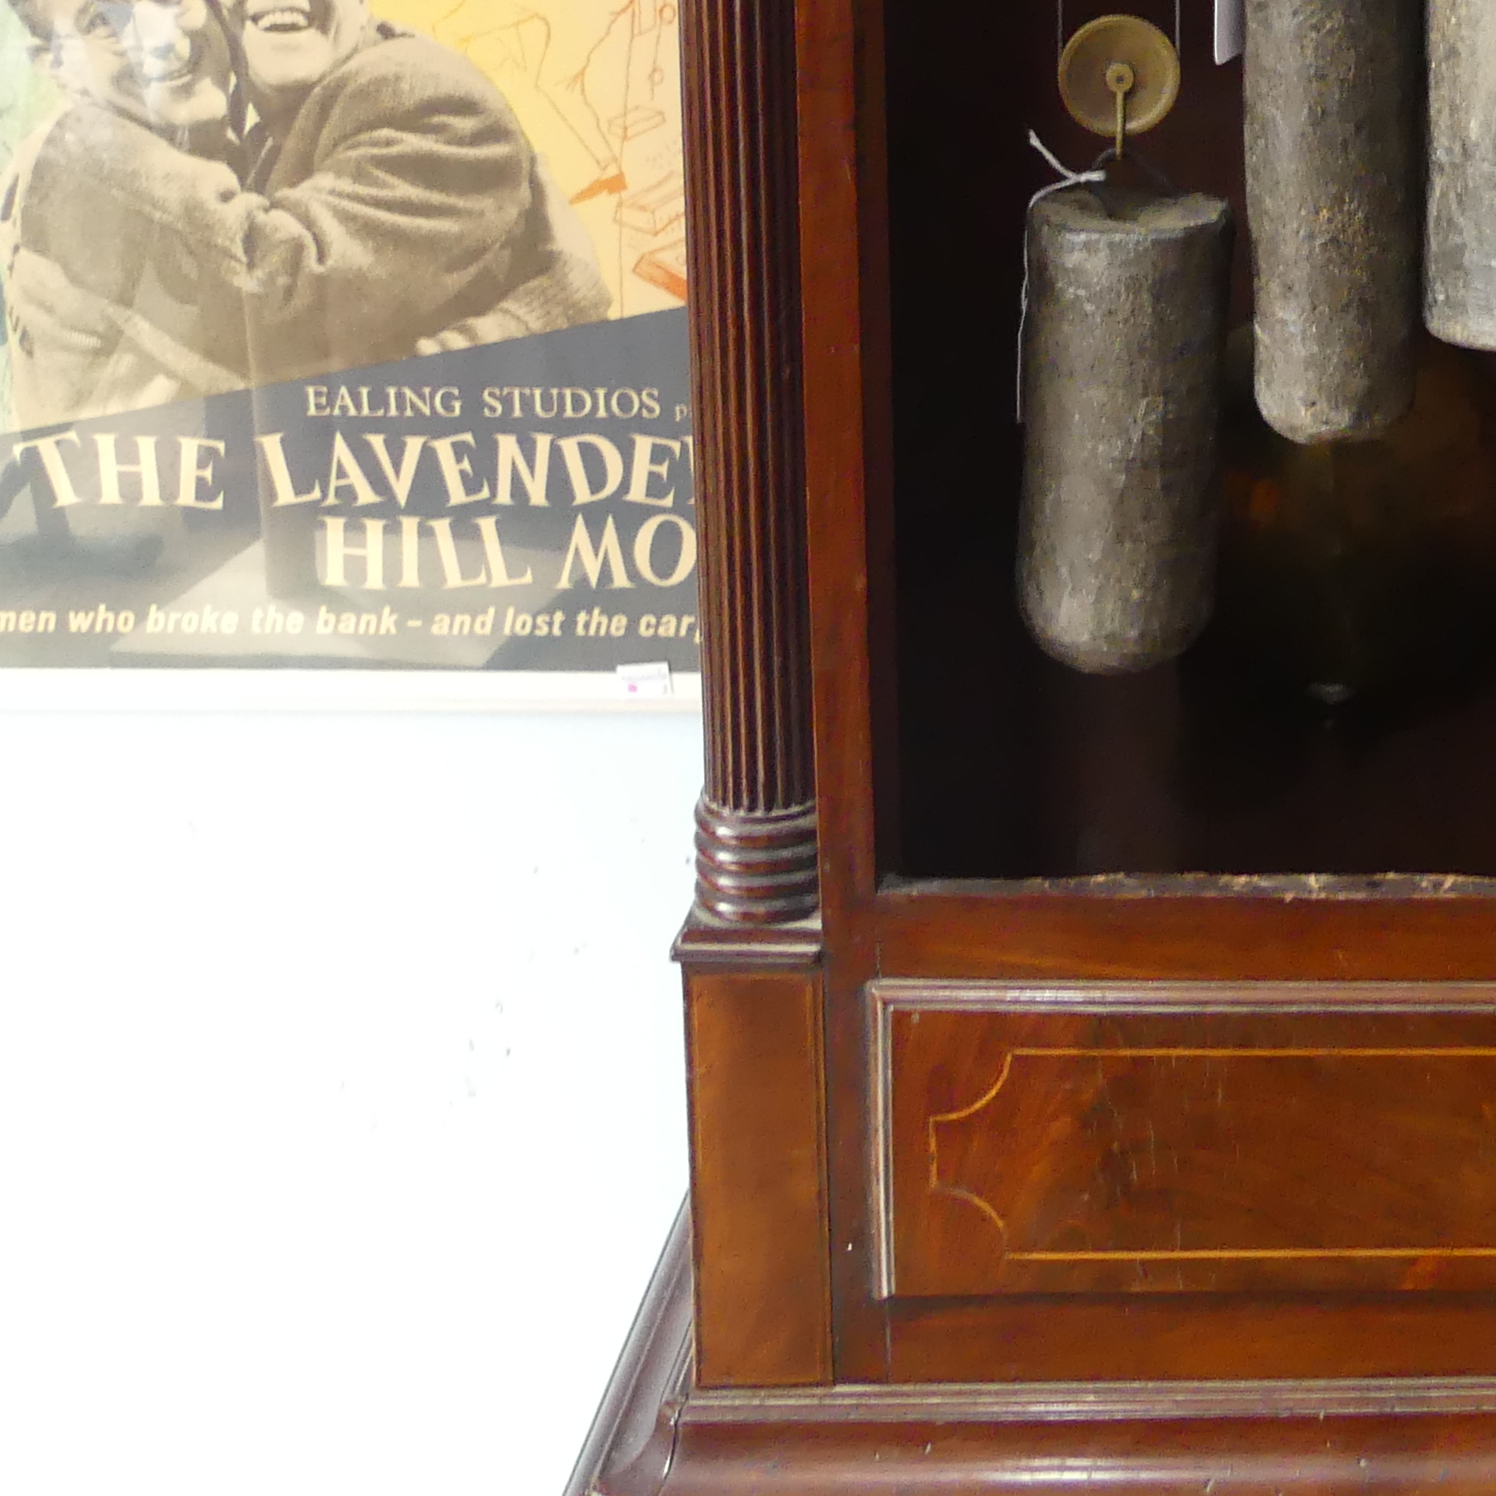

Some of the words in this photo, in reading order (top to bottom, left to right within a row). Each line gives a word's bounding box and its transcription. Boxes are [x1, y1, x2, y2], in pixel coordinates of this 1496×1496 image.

[305, 385, 462, 419] EALING
[482, 386, 661, 420] STUDIOS
[13, 430, 226, 510] THE
[256, 429, 697, 510] LAVENDE
[317, 514, 534, 591] HILL
[68, 603, 137, 635] who
[146, 603, 240, 636] broke
[252, 605, 306, 636] the
[316, 605, 398, 637] bank
[431, 606, 496, 637] and
[503, 606, 566, 638] lost
[575, 607, 631, 638] the
